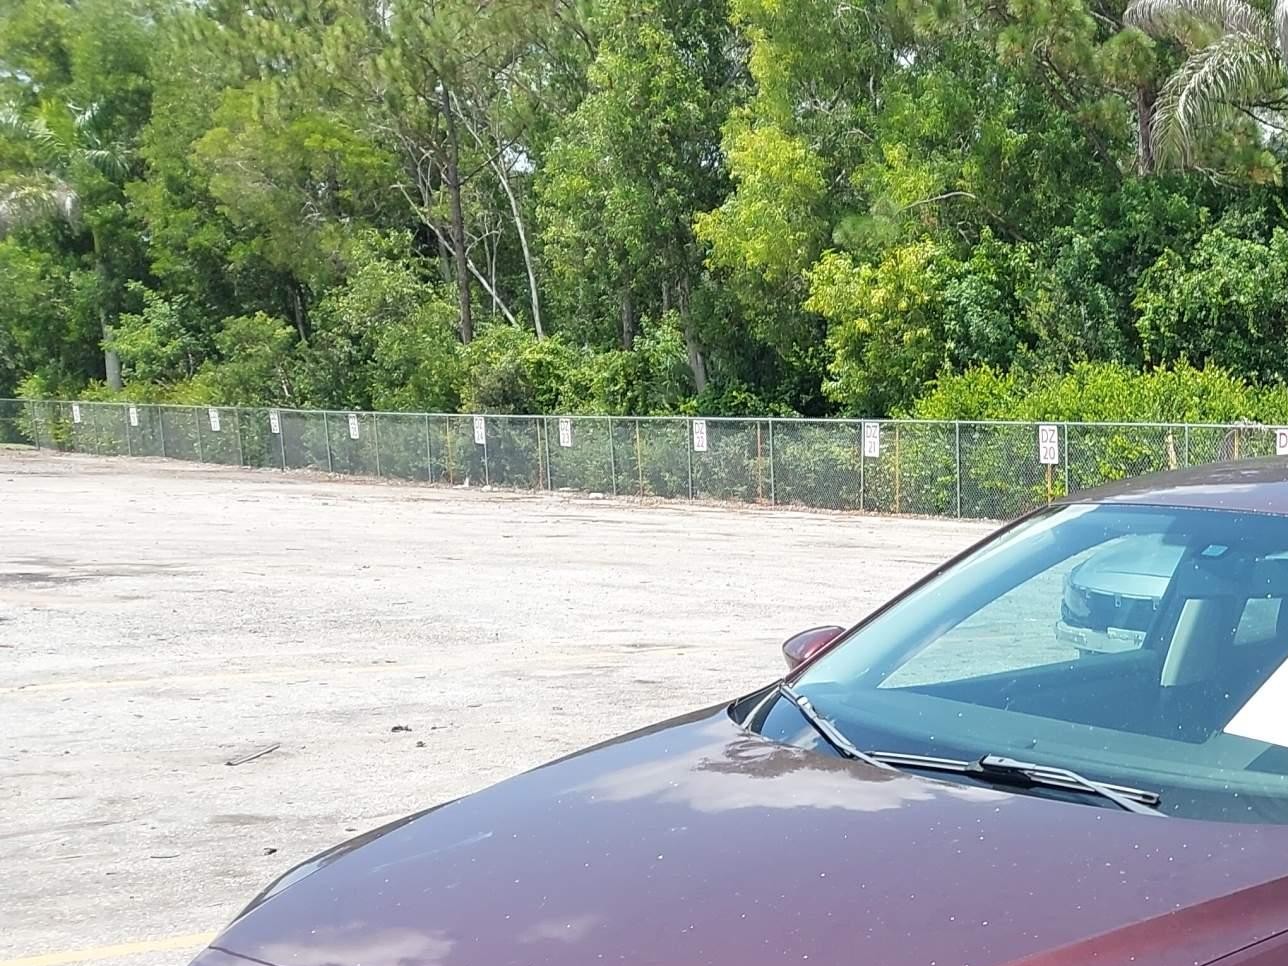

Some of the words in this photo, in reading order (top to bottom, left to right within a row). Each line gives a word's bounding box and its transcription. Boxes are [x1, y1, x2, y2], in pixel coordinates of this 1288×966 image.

[560, 420, 570, 431] DZ
[695, 422, 705, 435] DZ
[866, 425, 878, 438] DZ
[696, 436, 705, 448] 22
[1041, 429, 1057, 443] DZ
[868, 440, 876, 454] 21
[1043, 446, 1056, 460] 20
